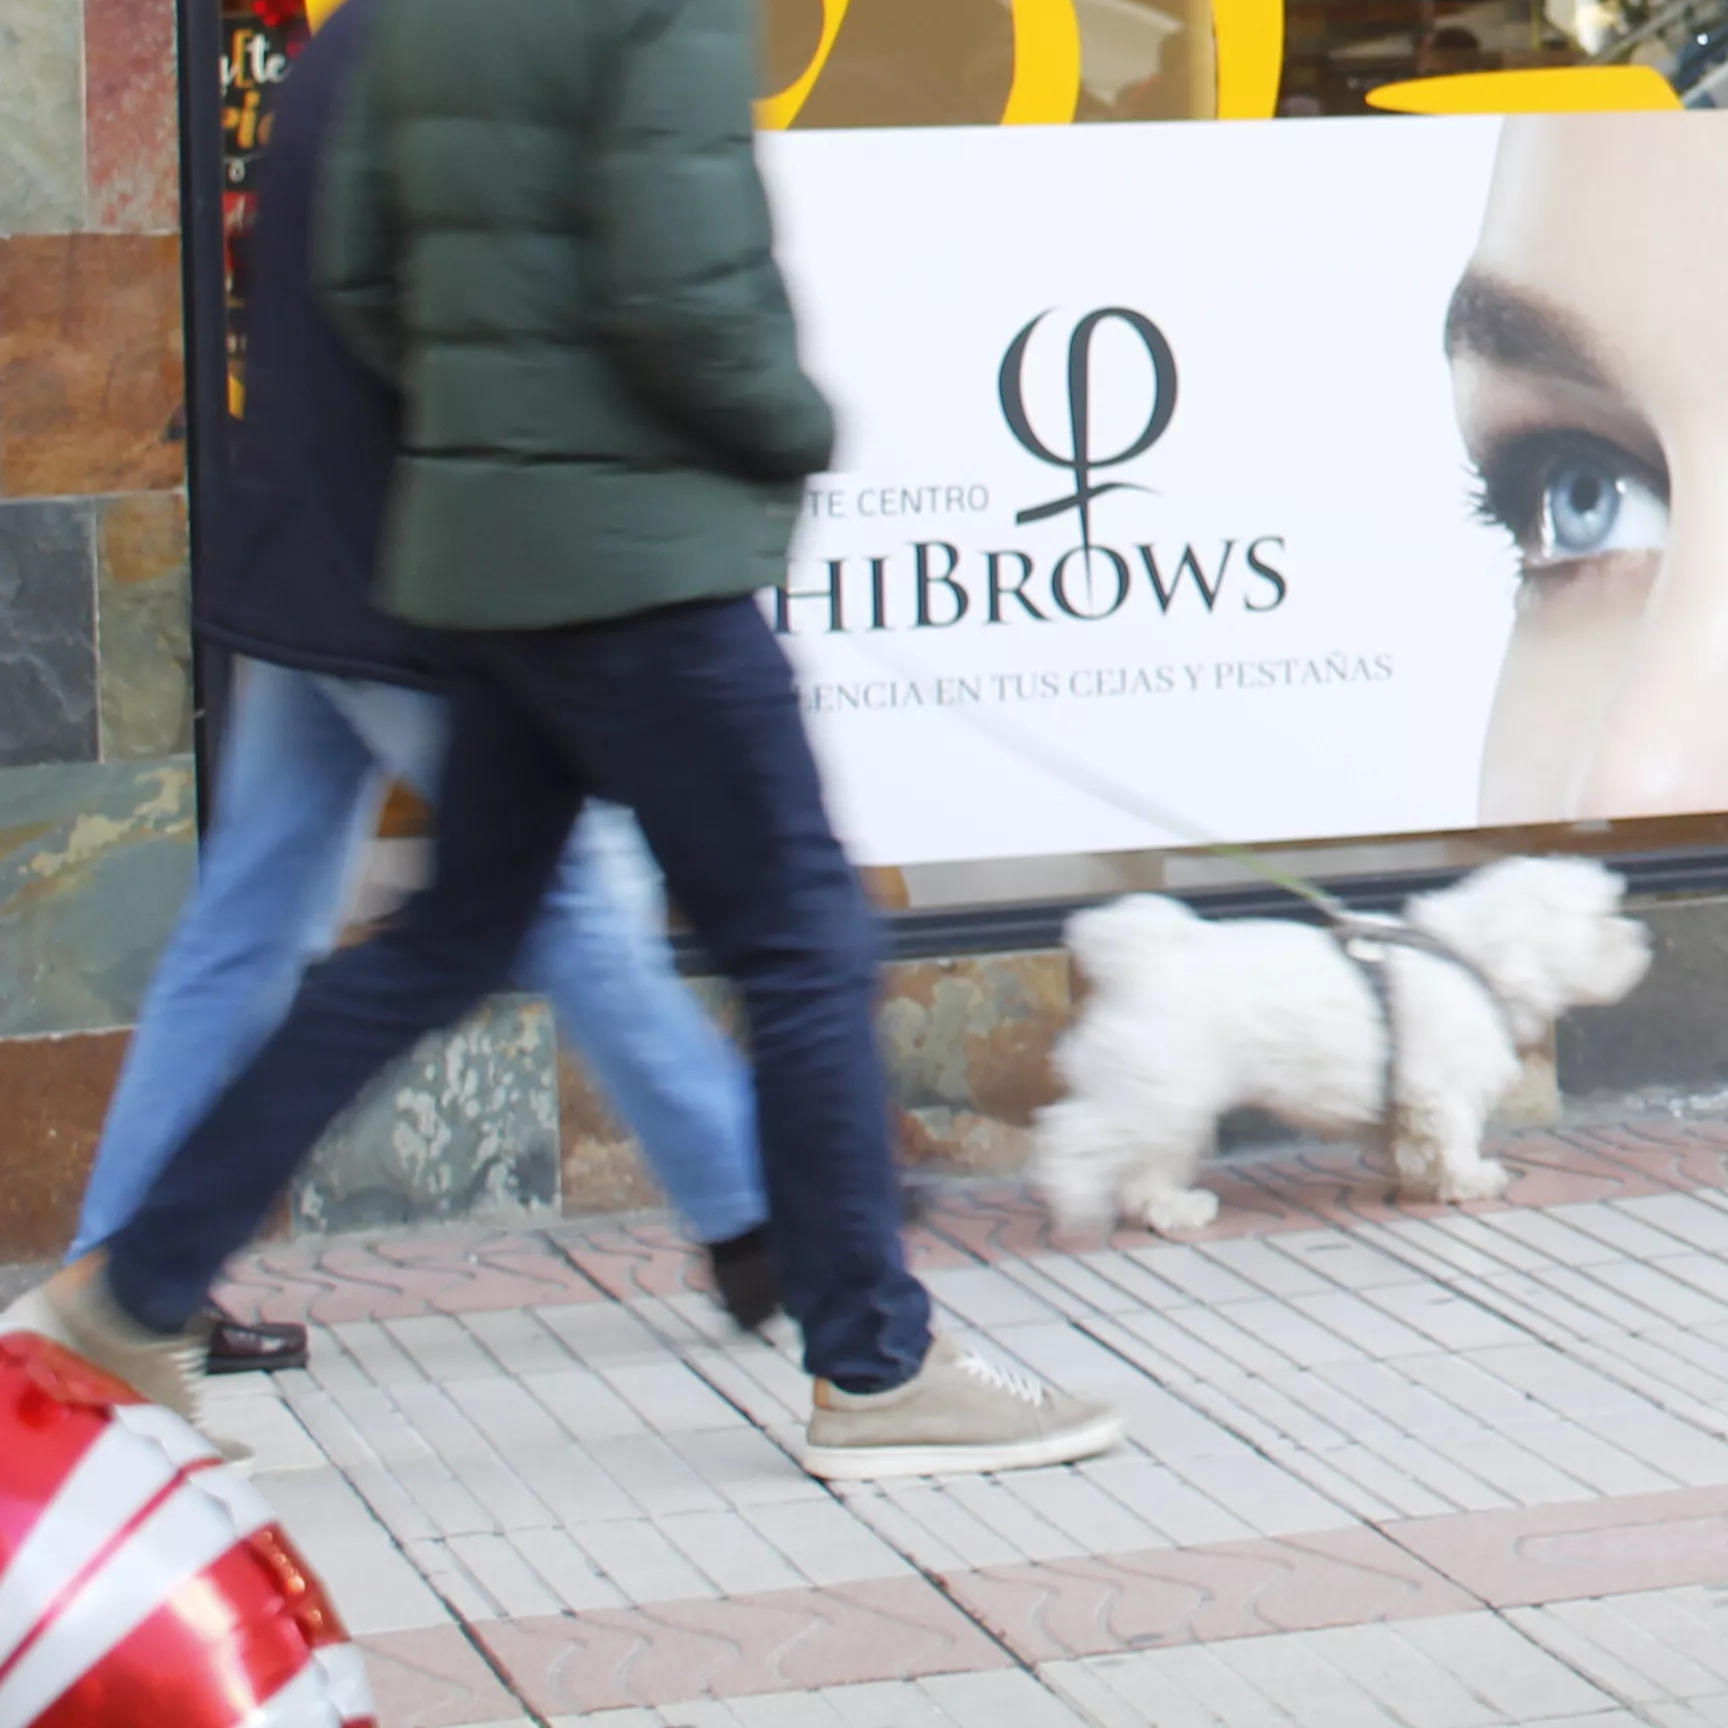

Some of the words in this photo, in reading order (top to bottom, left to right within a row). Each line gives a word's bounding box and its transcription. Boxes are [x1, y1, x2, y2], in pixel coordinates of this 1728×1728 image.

[856, 483, 990, 518] CENTRO
[936, 675, 982, 707] EN
[991, 671, 1060, 702] TUS
[1069, 664, 1175, 699] CEJAS
[1182, 663, 1204, 691] Y
[1214, 649, 1394, 690] PESTAÑAS
